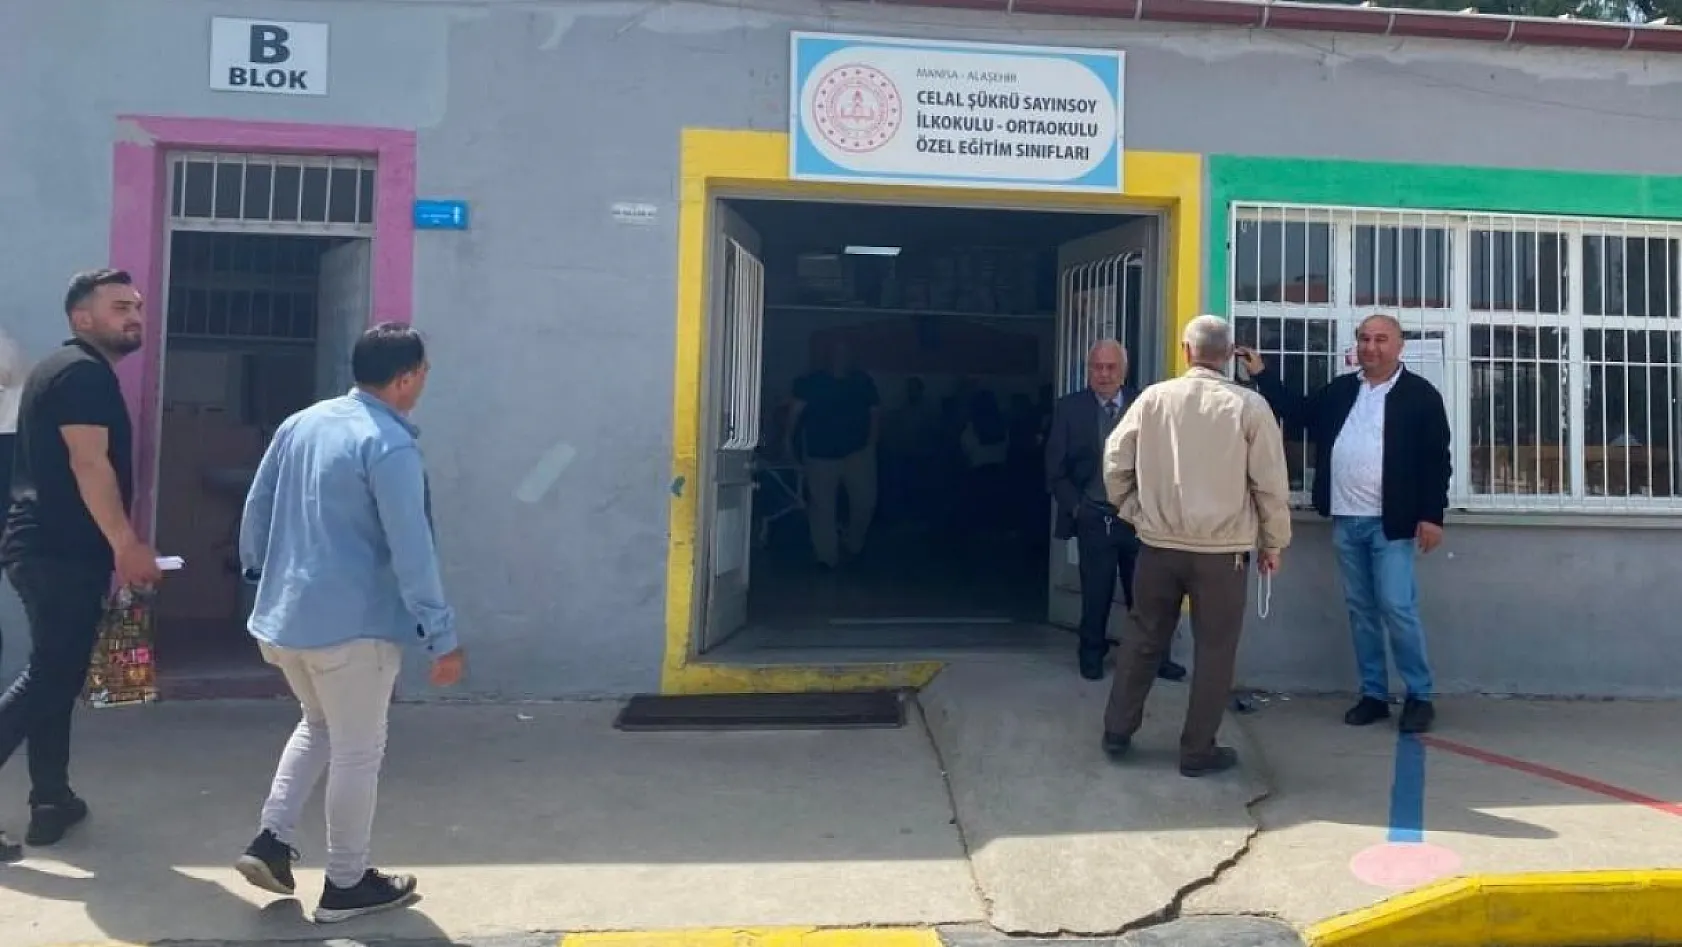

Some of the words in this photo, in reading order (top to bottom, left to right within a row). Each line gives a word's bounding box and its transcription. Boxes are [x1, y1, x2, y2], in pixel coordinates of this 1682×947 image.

[250, 24, 290, 63] B
[229, 67, 308, 89] BLOK
[917, 90, 964, 106] CELAL
[967, 91, 1019, 110] ŞÜKRÜ
[1023, 96, 1097, 113] SAYINSOY
[917, 110, 993, 131] İLKOKULU
[1006, 118, 1098, 137] ORTAOKULU
[917, 135, 955, 153] ÖZEL
[959, 138, 1011, 156] EĞİTİM
[1016, 144, 1088, 160] SINIFLARI
